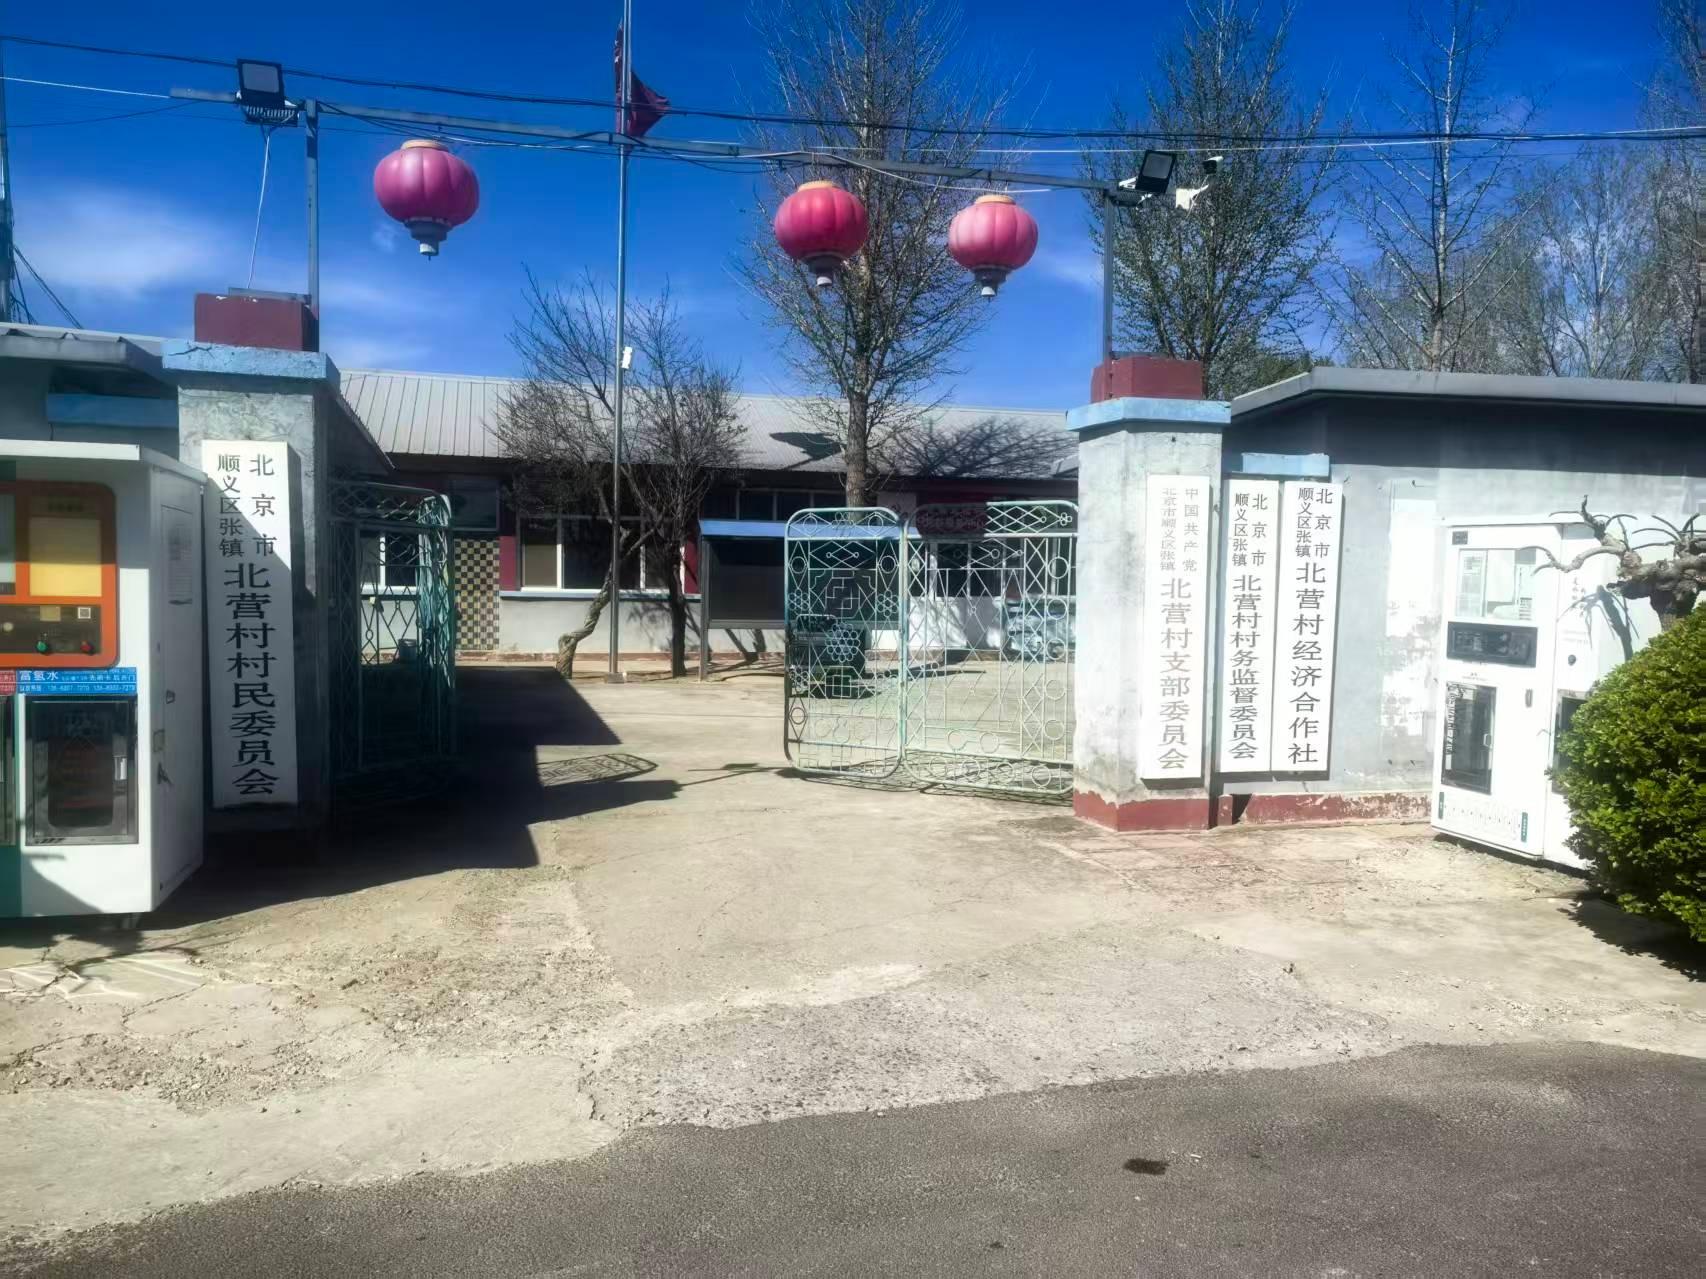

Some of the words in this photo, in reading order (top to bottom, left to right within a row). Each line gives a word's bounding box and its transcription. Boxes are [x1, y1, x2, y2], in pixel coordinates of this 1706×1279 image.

[217, 453, 244, 558] 顺义区张镇
[250, 454, 277, 557] 北京市
[1159, 487, 1177, 571] 北京市顺义区张镇
[1182, 487, 1200, 572] 中国共产党
[1231, 492, 1250, 567] 顺义区张镇
[1251, 493, 1268, 567] 北京市
[1295, 487, 1314, 558] 顺义区张镇
[1314, 487, 1333, 559] 北京市
[223, 562, 280, 795] 北营村村民委员会
[1157, 577, 1193, 770] 北营村支部委员会
[1228, 574, 1263, 760] 北营村村务监督委员会
[1287, 561, 1327, 765] 北营村经济合作社
